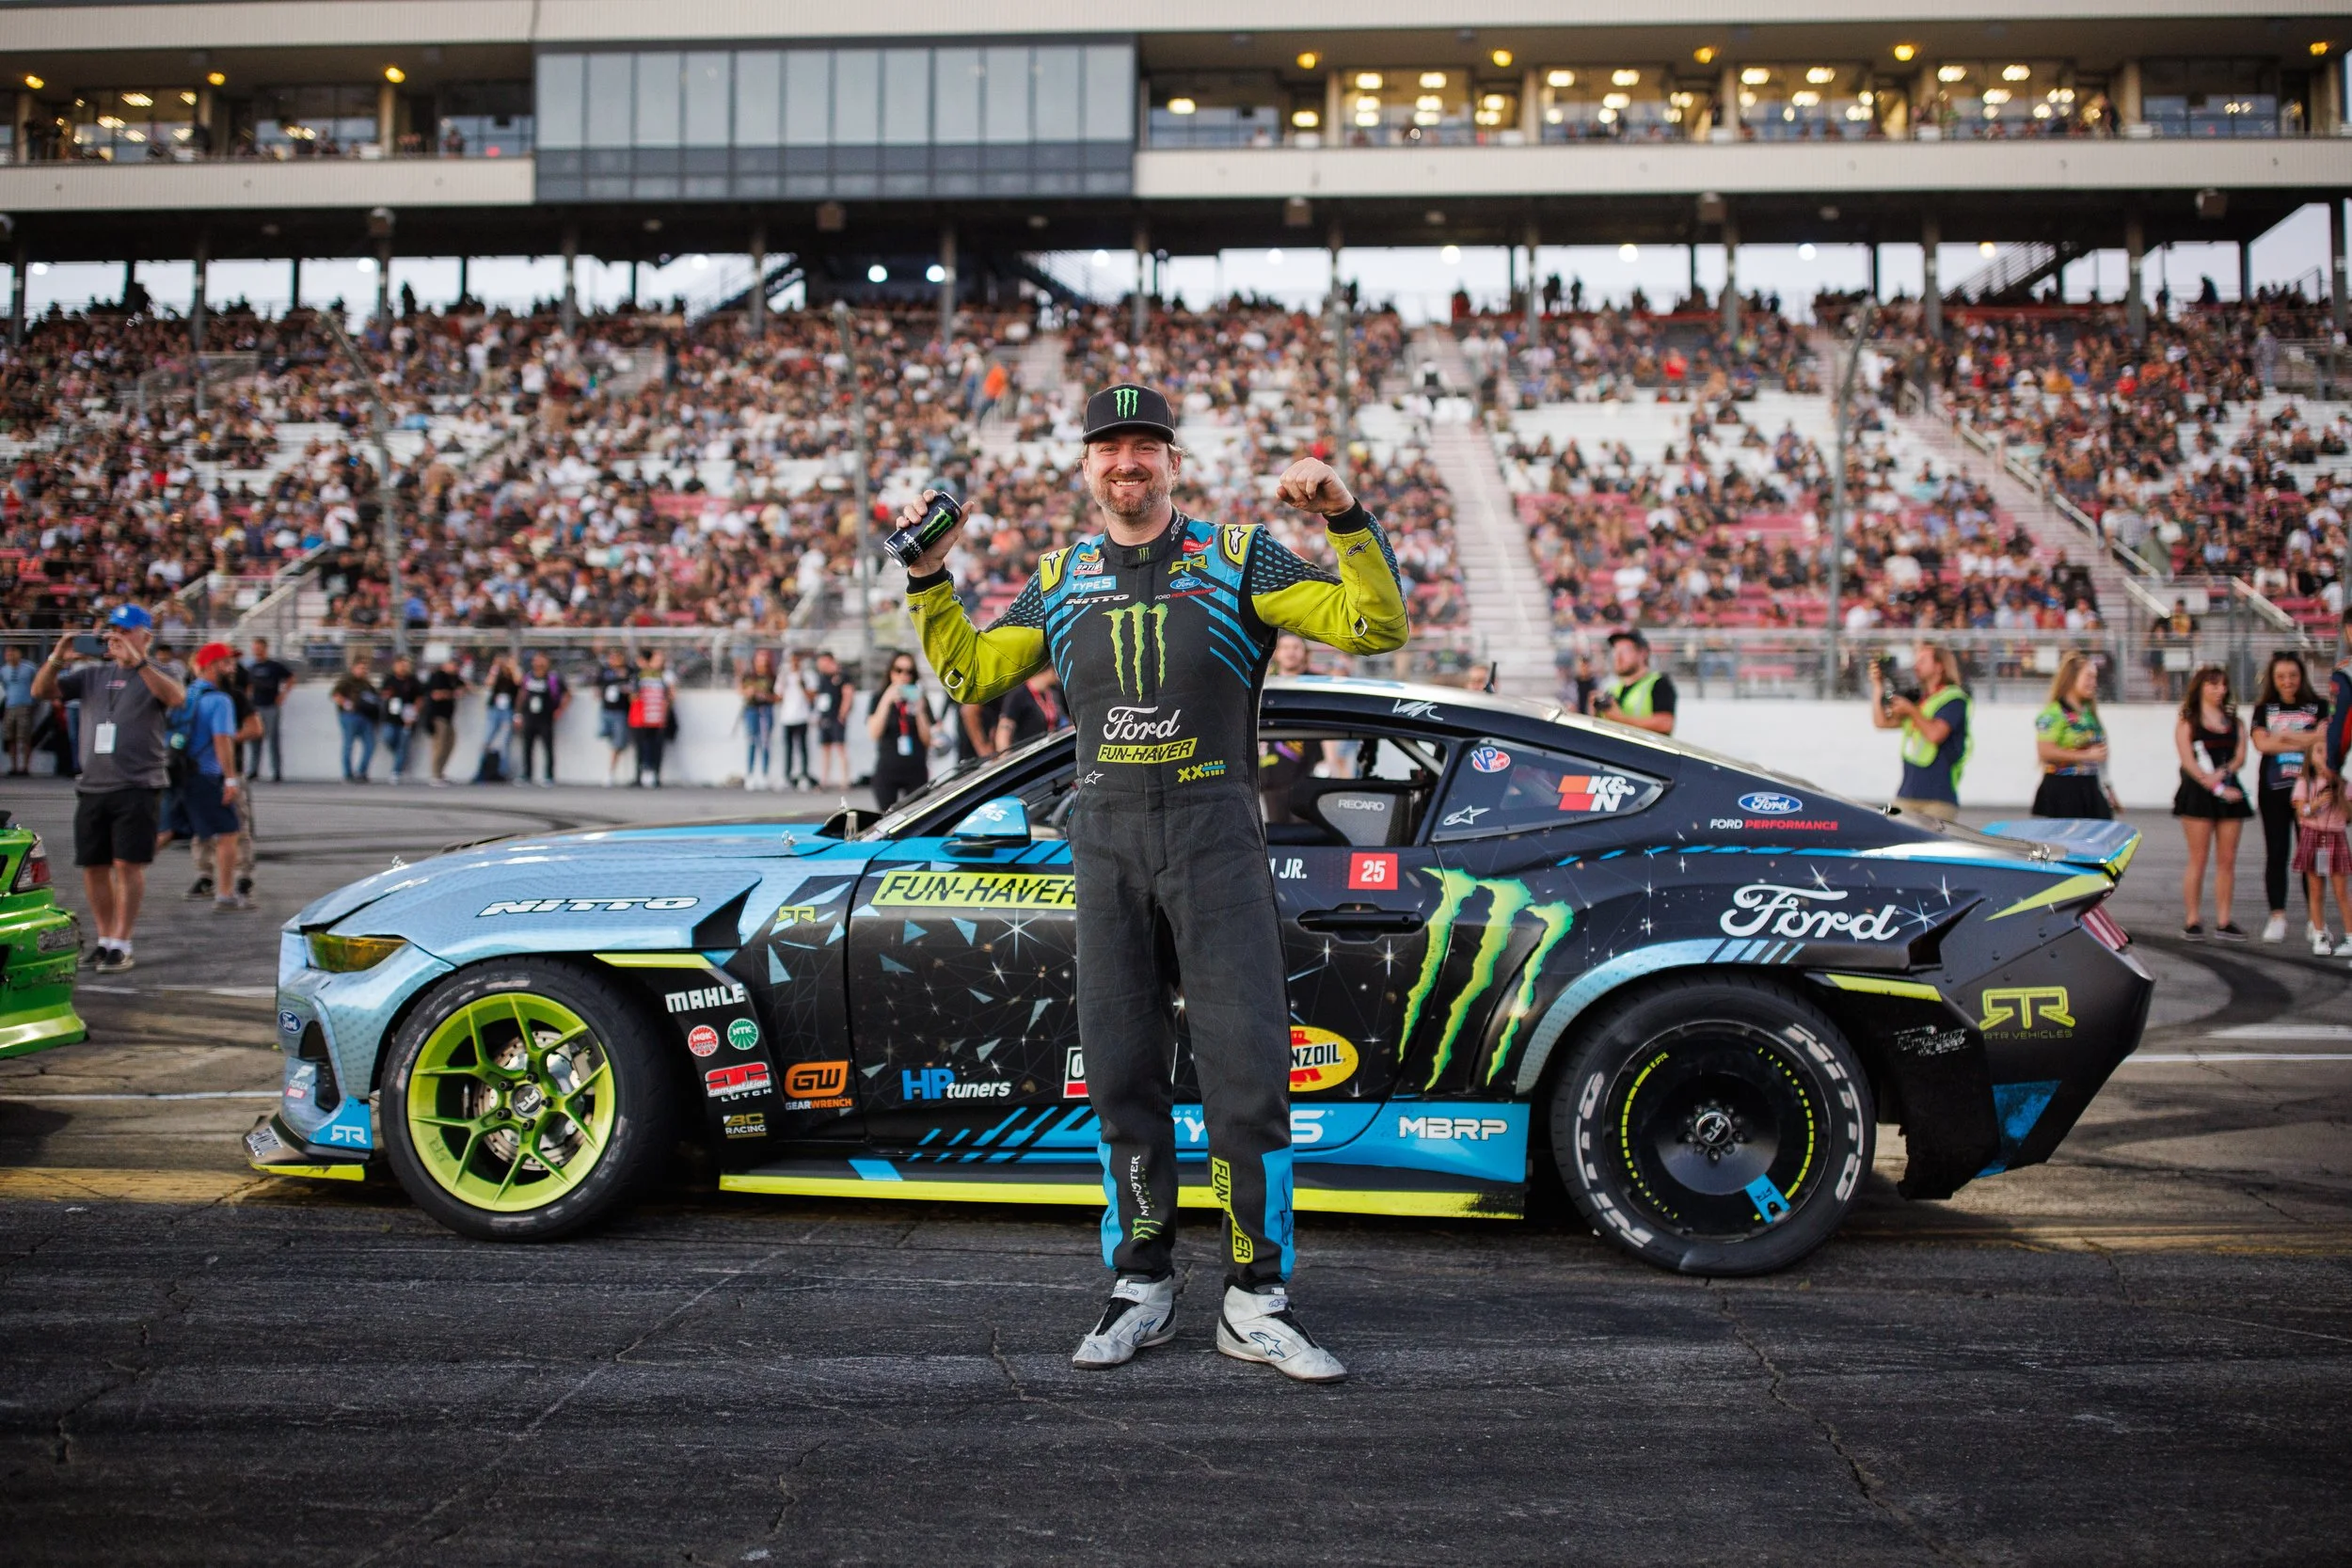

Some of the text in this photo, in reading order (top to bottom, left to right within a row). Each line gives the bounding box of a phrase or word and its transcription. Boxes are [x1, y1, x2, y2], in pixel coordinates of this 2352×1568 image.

[1176, 579, 1196, 588] Ford
[1066, 594, 1129, 605] NITTO
[1103, 705, 1181, 740] Ford
[1101, 742, 1192, 762] FUN-HAVER
[1471, 747, 1497, 771] VP
[1338, 799, 1385, 811] RECARO
[1751, 796, 1790, 812] Ford
[1709, 818, 1838, 831] FORD PERFORMANCE
[1279, 858, 1308, 879] JR.
[1360, 860, 1387, 882] 25
[477, 895, 701, 918] NITTO
[1720, 884, 1900, 942] Ford
[664, 982, 746, 1013] MAHLE
[692, 1032, 712, 1042] NGK
[732, 1025, 752, 1036] NTK
[2013, 1030, 2073, 1039] VEHICLES
[1292, 1043, 1341, 1068] NZOIL
[785, 1098, 852, 1111] GEARWRENCH
[725, 1125, 766, 1135] RACING
[1399, 1117, 1507, 1141] MBRP
[1130, 1155, 1150, 1217] MONSTER
